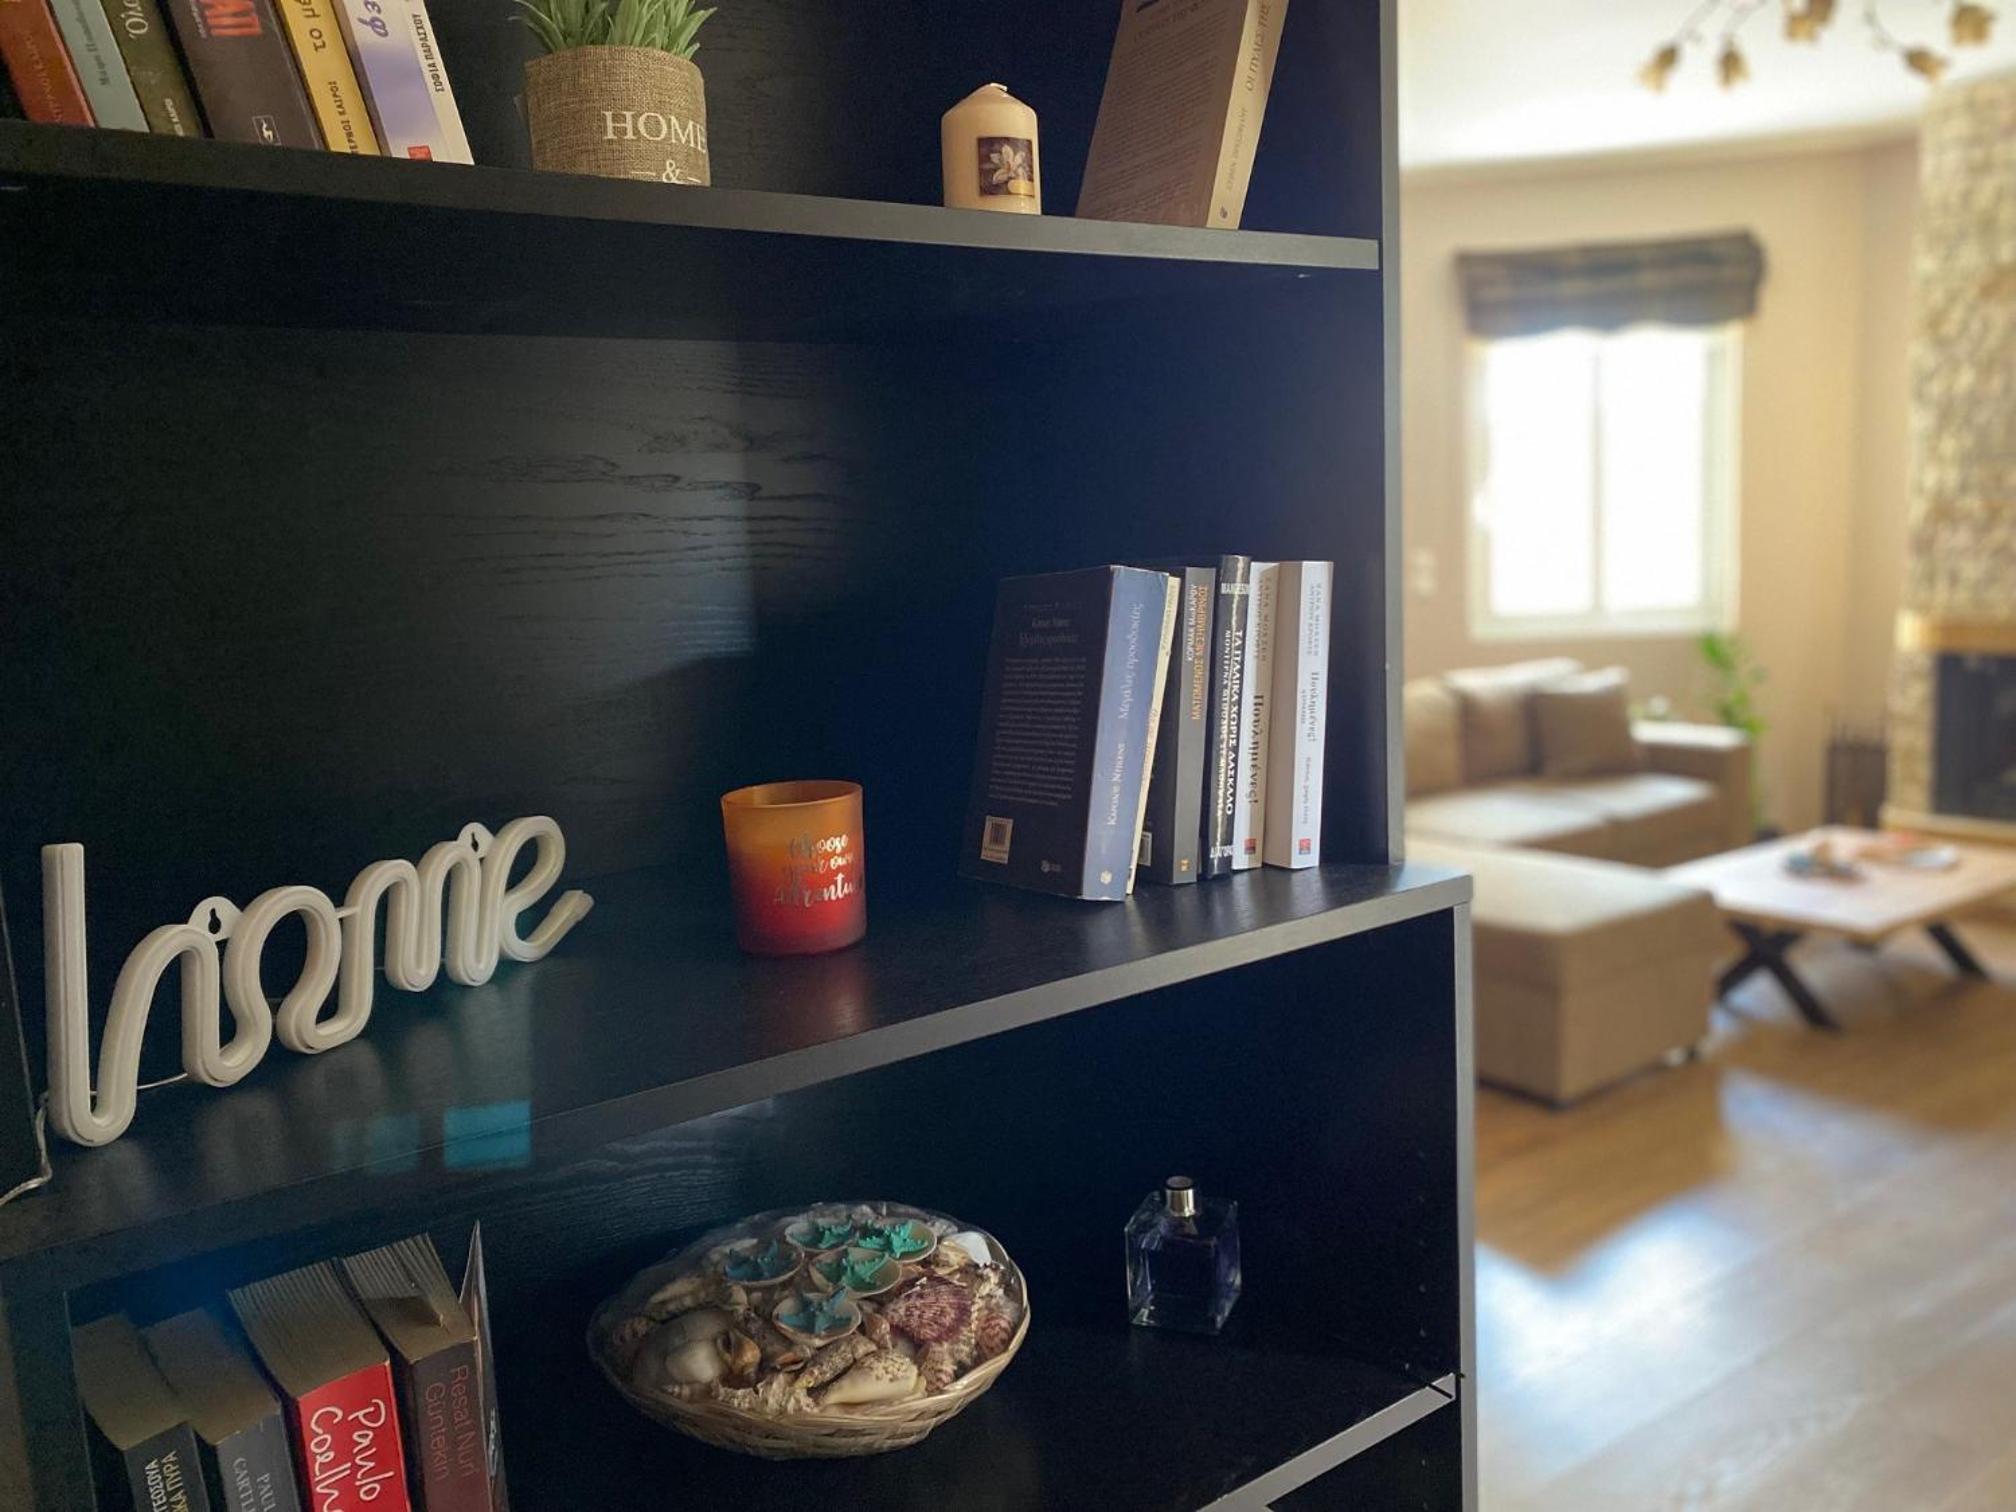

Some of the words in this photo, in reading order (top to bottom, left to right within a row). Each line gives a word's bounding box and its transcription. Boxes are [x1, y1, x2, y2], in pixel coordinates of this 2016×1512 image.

[427, 61, 445, 94] ΣΟΦΙΑ
[1229, 650, 1243, 703] ΙΤΑΛΙΚΑ
[1228, 705, 1241, 747] ΧΩΡΙΣ
[1224, 751, 1237, 815] ΔΑΣΚΑΛΟ
[42, 815, 594, 1147] home
[348, 1398, 396, 1502] Paulo
